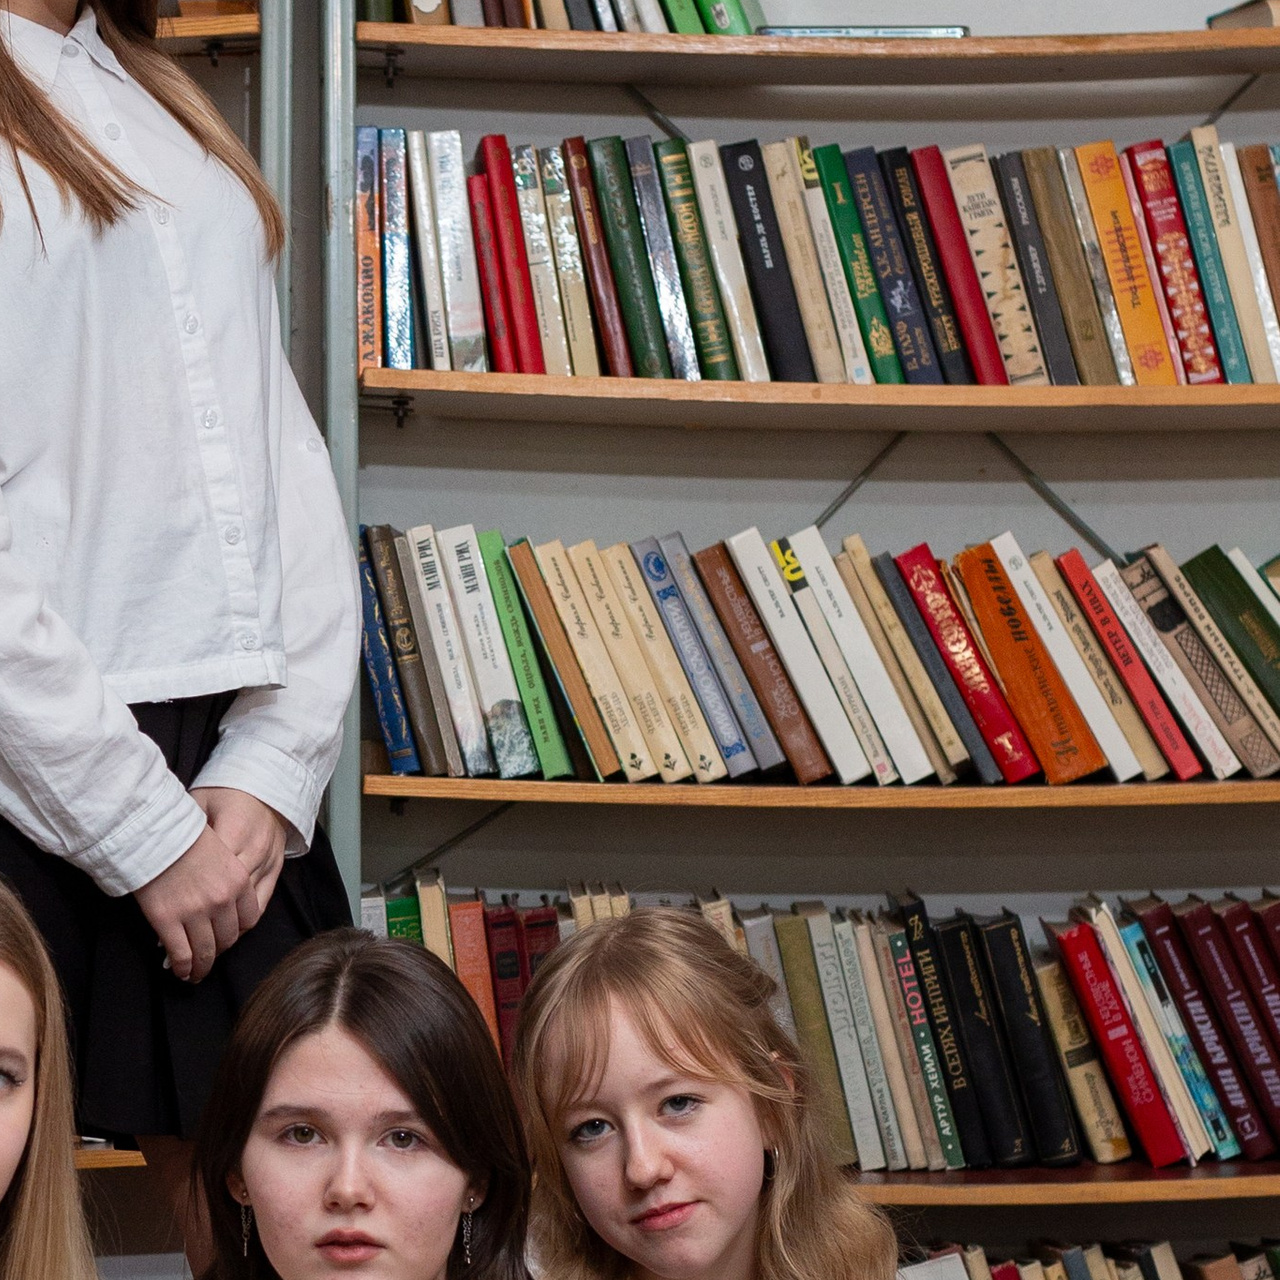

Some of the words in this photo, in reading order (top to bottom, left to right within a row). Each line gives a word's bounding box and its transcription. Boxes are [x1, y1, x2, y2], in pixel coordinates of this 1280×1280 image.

[746, 183, 761, 220] КОСТЕР
[894, 166, 915, 207] РОМАН
[755, 222, 766, 234] ДЕ
[855, 171, 885, 248] АНДЕРСЕН
[758, 235, 773, 268] ШАРЛЬ
[895, 319, 914, 355] ГАУФ
[416, 538, 437, 558] РИД
[454, 540, 474, 561] РИД
[421, 560, 441, 590] МАЙН
[460, 564, 480, 594] МАЙН
[493, 558, 514, 613] СЕМИНОЛОВ
[1079, 578, 1105, 615] ИВАХ
[1173, 572, 1205, 621] ВОПРОС
[509, 614, 524, 647] ВОЖДЬ
[1099, 615, 1111, 626] В
[1106, 627, 1133, 667] ВЕТЕР
[1205, 621, 1244, 682] ТРУДНЫЙ
[531, 696, 542, 715] РИД
[537, 717, 550, 743] МАЙН
[898, 950, 926, 1025] HOTEL
[918, 949, 947, 1022] ИНТРИГИ
[921, 1044, 939, 1089] ХЕЙЛИ
[938, 1026, 961, 1075] СЕТЯХ
[953, 1077, 967, 1089] В
[934, 1094, 953, 1136] АРТУР
